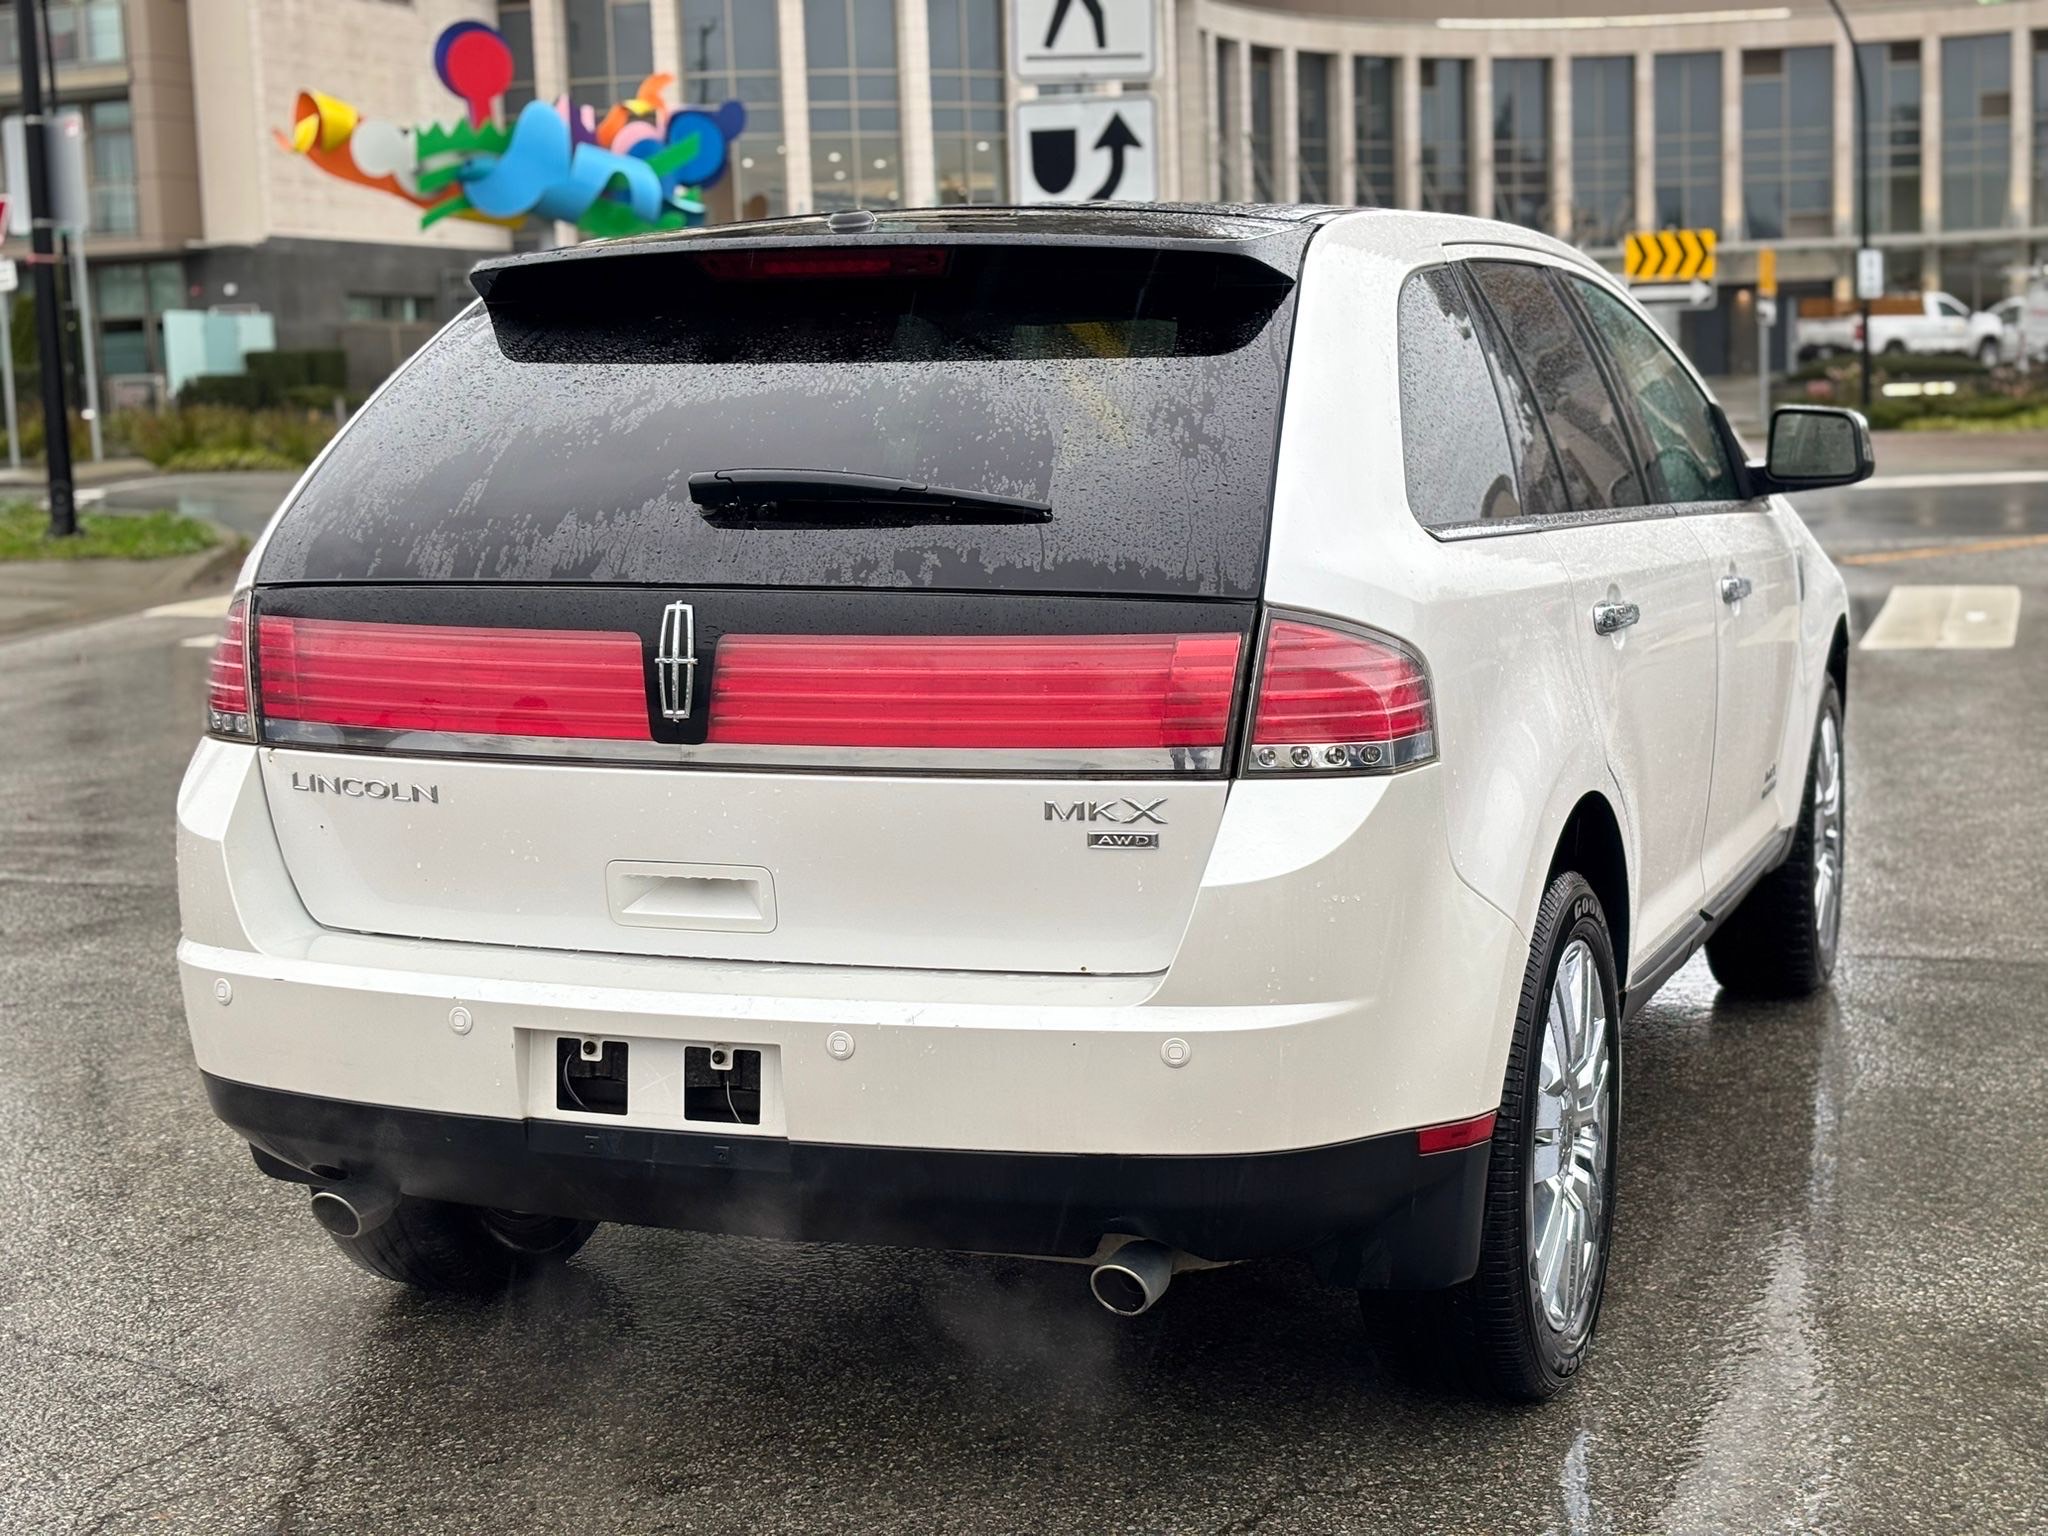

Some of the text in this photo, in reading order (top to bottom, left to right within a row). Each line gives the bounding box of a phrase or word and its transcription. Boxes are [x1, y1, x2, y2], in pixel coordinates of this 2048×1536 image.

[292, 771, 439, 804] LINCOLN
[1044, 797, 1168, 824] MKX
[1097, 834, 1150, 846] AWD
